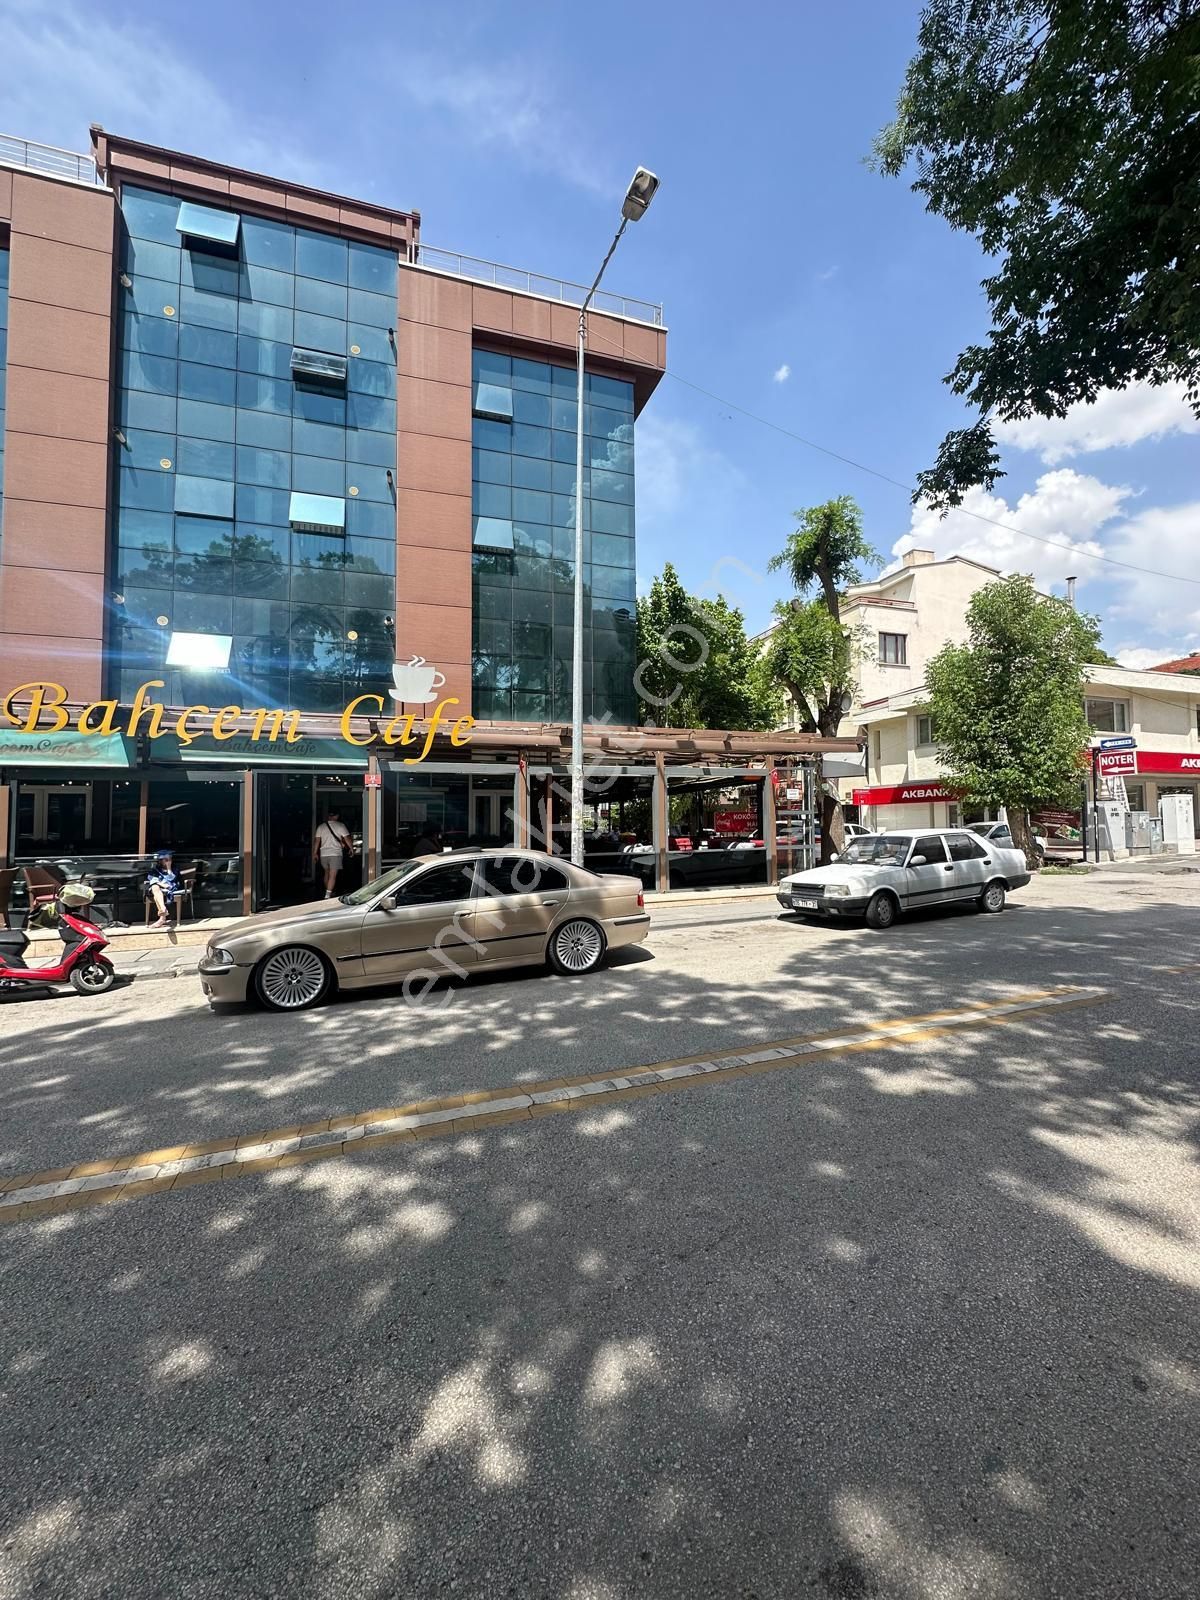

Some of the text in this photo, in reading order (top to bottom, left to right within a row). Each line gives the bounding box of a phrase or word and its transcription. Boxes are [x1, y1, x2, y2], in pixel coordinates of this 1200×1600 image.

[2, 680, 475, 765] Bahçem Cafe
[1101, 754, 1134, 766] NOTER
[902, 788, 950, 799] AKBANK
